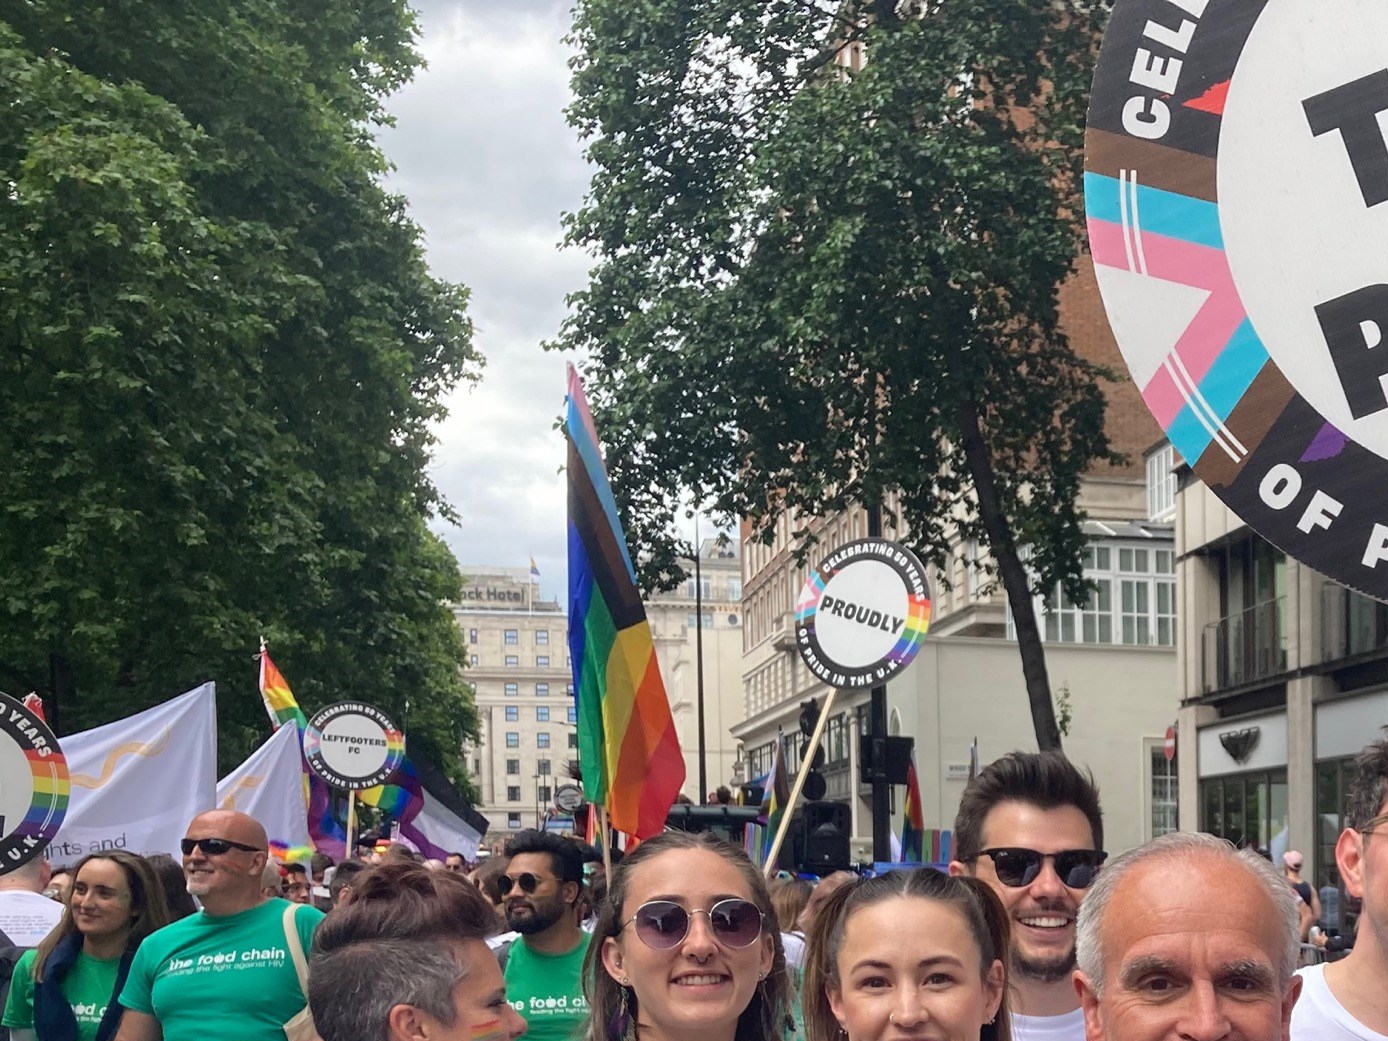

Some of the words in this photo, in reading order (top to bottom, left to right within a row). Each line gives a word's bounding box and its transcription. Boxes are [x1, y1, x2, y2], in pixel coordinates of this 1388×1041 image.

[1258, 463, 1345, 535] OF
[822, 542, 895, 574] CELEBRATING
[893, 551, 908, 567] 50
[905, 562, 926, 602] YEARS
[486, 587, 525, 602] Hotel
[819, 595, 906, 635] PROUDLY
[798, 627, 810, 645] OF
[804, 647, 831, 679] PRIDE
[832, 673, 846, 687] IN
[850, 673, 874, 687] THE
[876, 658, 902, 679] U.K.
[8, 708, 53, 758] YEARS
[314, 704, 364, 727] CELEBRATING
[375, 713, 396, 734] YEARS
[322, 733, 387, 748] LEFTFOOTERS
[348, 747, 361, 755] FC
[312, 759, 323, 770] OF
[321, 770, 346, 787] PRIDE
[349, 781, 360, 789] IN
[361, 777, 379, 788] THE
[7, 832, 44, 861] U.K.
[89, 832, 127, 852] and
[241, 946, 285, 961] chain
